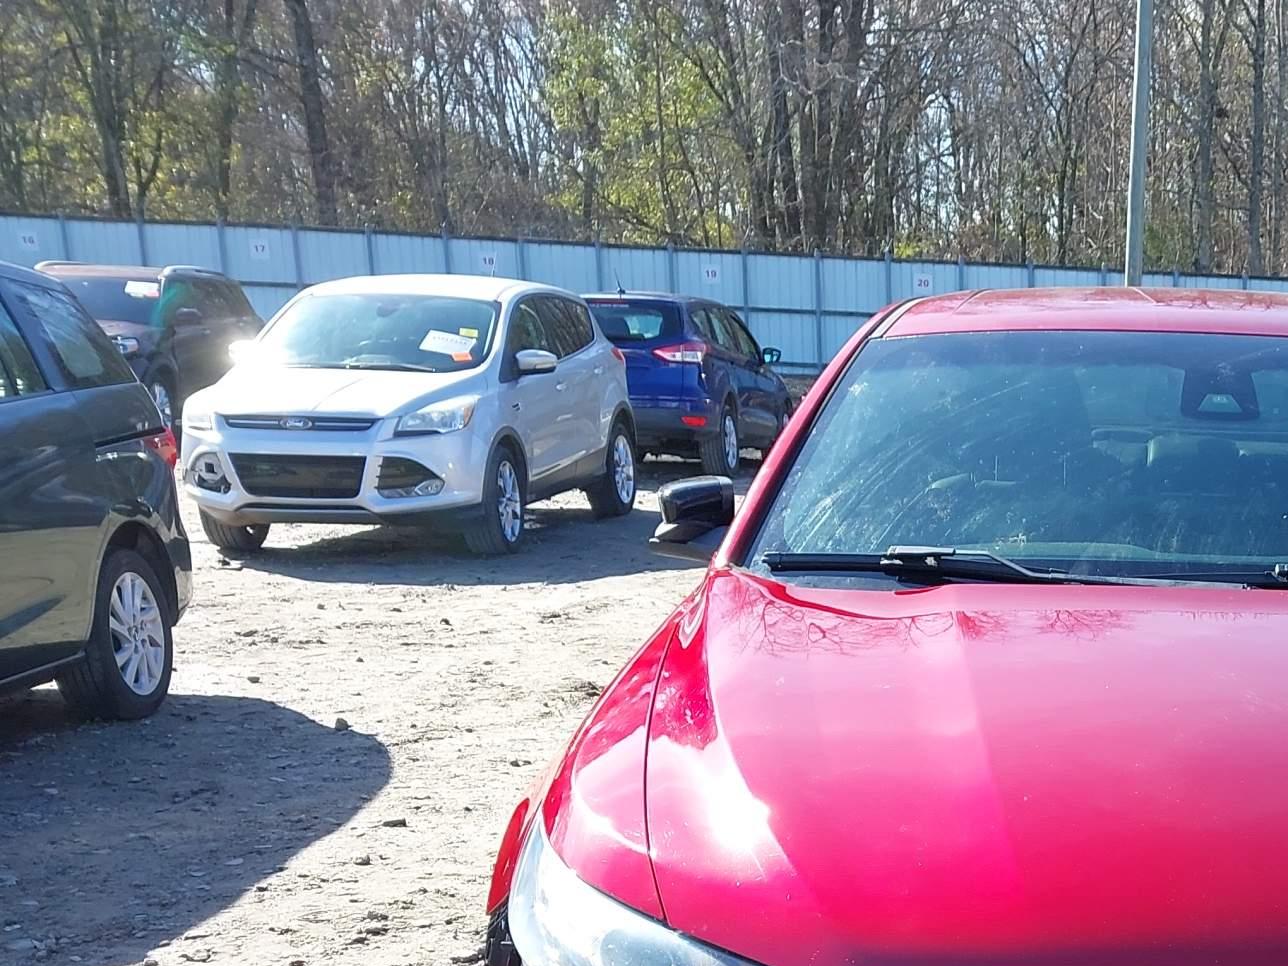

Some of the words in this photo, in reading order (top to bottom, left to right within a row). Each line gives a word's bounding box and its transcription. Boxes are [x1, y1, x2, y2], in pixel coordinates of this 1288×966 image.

[254, 245, 265, 253] 17
[705, 270, 717, 279] 19
[917, 278, 930, 288] 20
